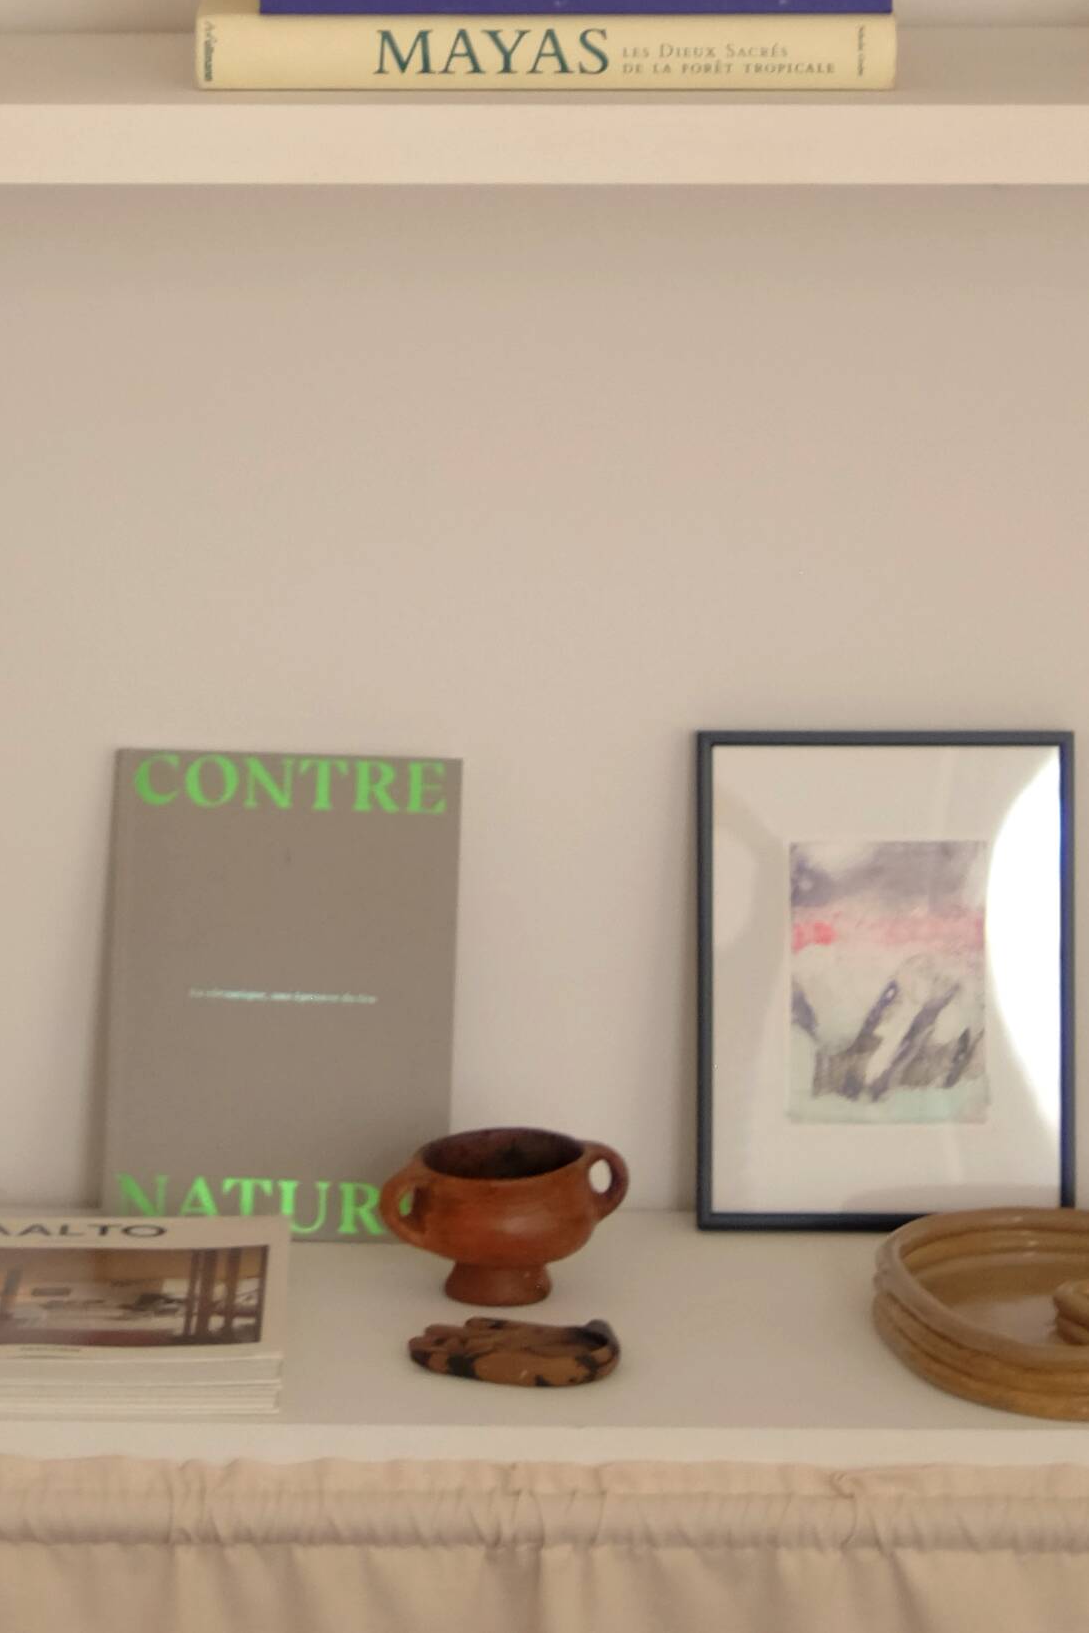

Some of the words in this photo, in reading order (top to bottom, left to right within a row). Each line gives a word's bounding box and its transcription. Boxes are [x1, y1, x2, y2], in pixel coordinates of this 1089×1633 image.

[374, 28, 610, 75] MAYAS
[133, 753, 448, 814] CONTRE
[118, 1173, 412, 1235] NATUR
